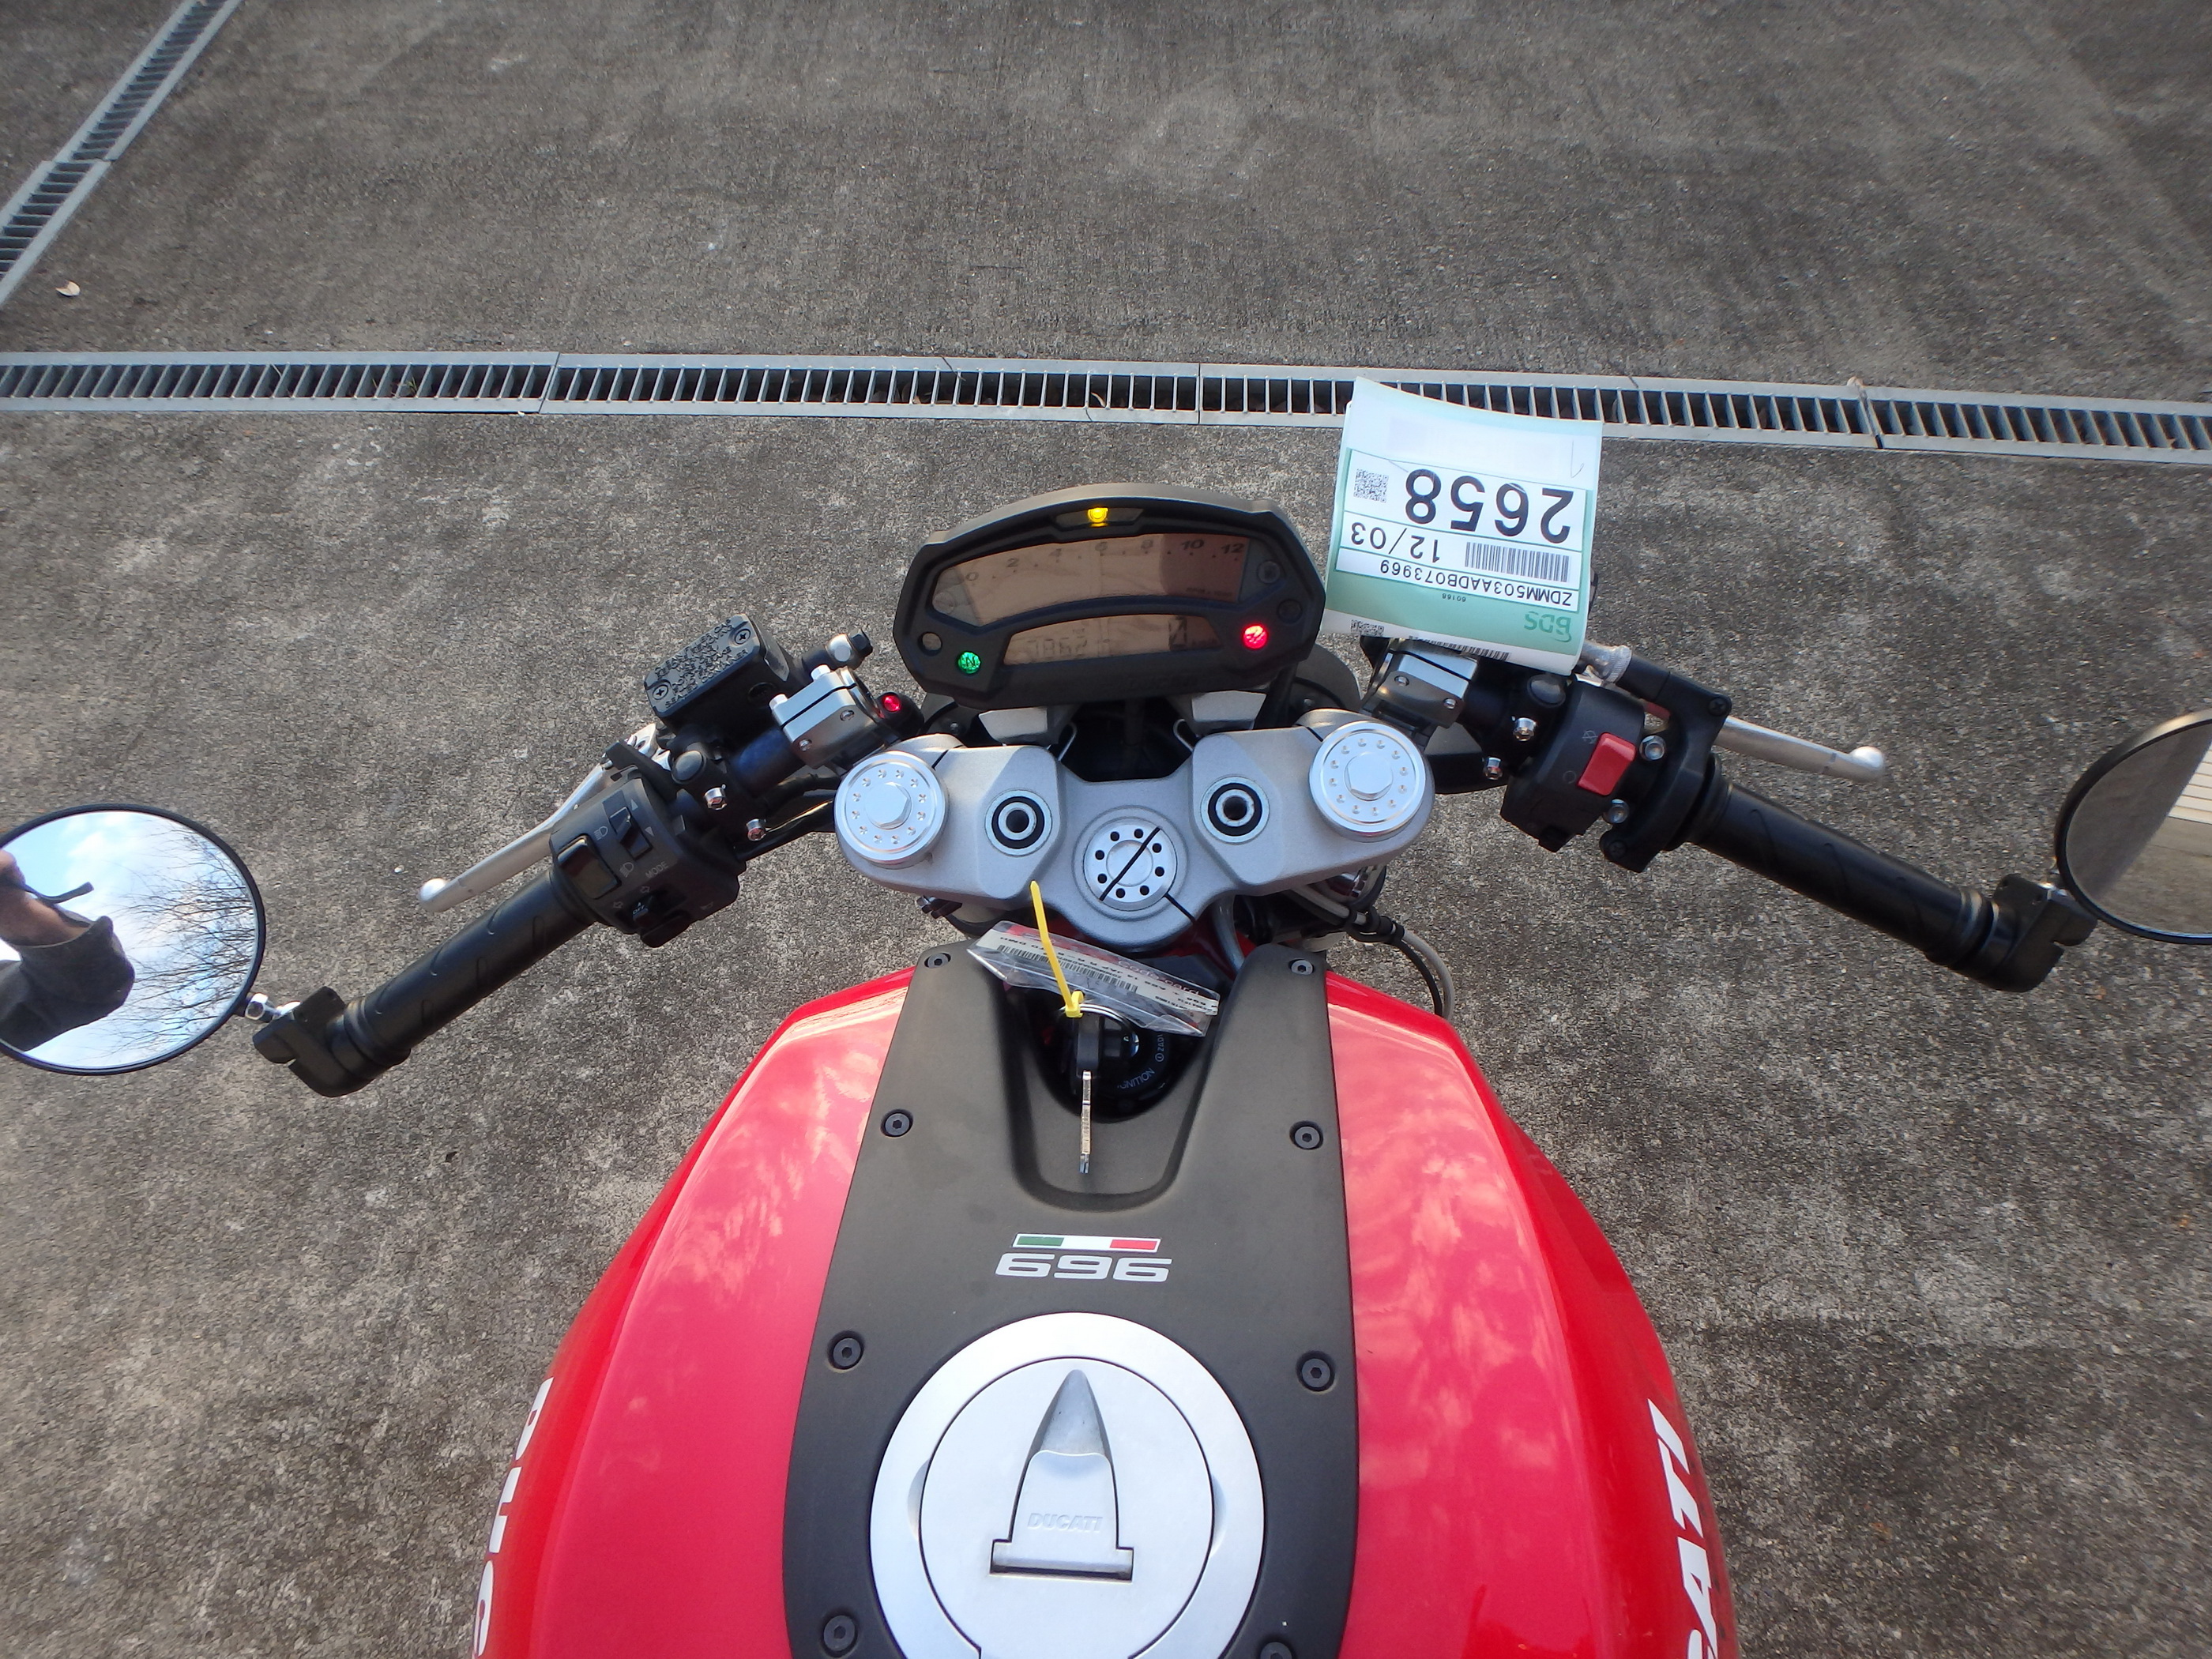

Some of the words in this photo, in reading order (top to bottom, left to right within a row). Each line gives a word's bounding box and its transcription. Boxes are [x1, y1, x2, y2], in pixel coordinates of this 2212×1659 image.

[1405, 469, 1574, 544] 2658
[1181, 539, 1205, 550] 10
[1221, 543, 1244, 555] 12
[1350, 522, 1441, 563] 12/03
[645, 860, 670, 879] MODE
[995, 1253, 1172, 1282] 696
[1027, 1513, 1103, 1533] DUCATI
